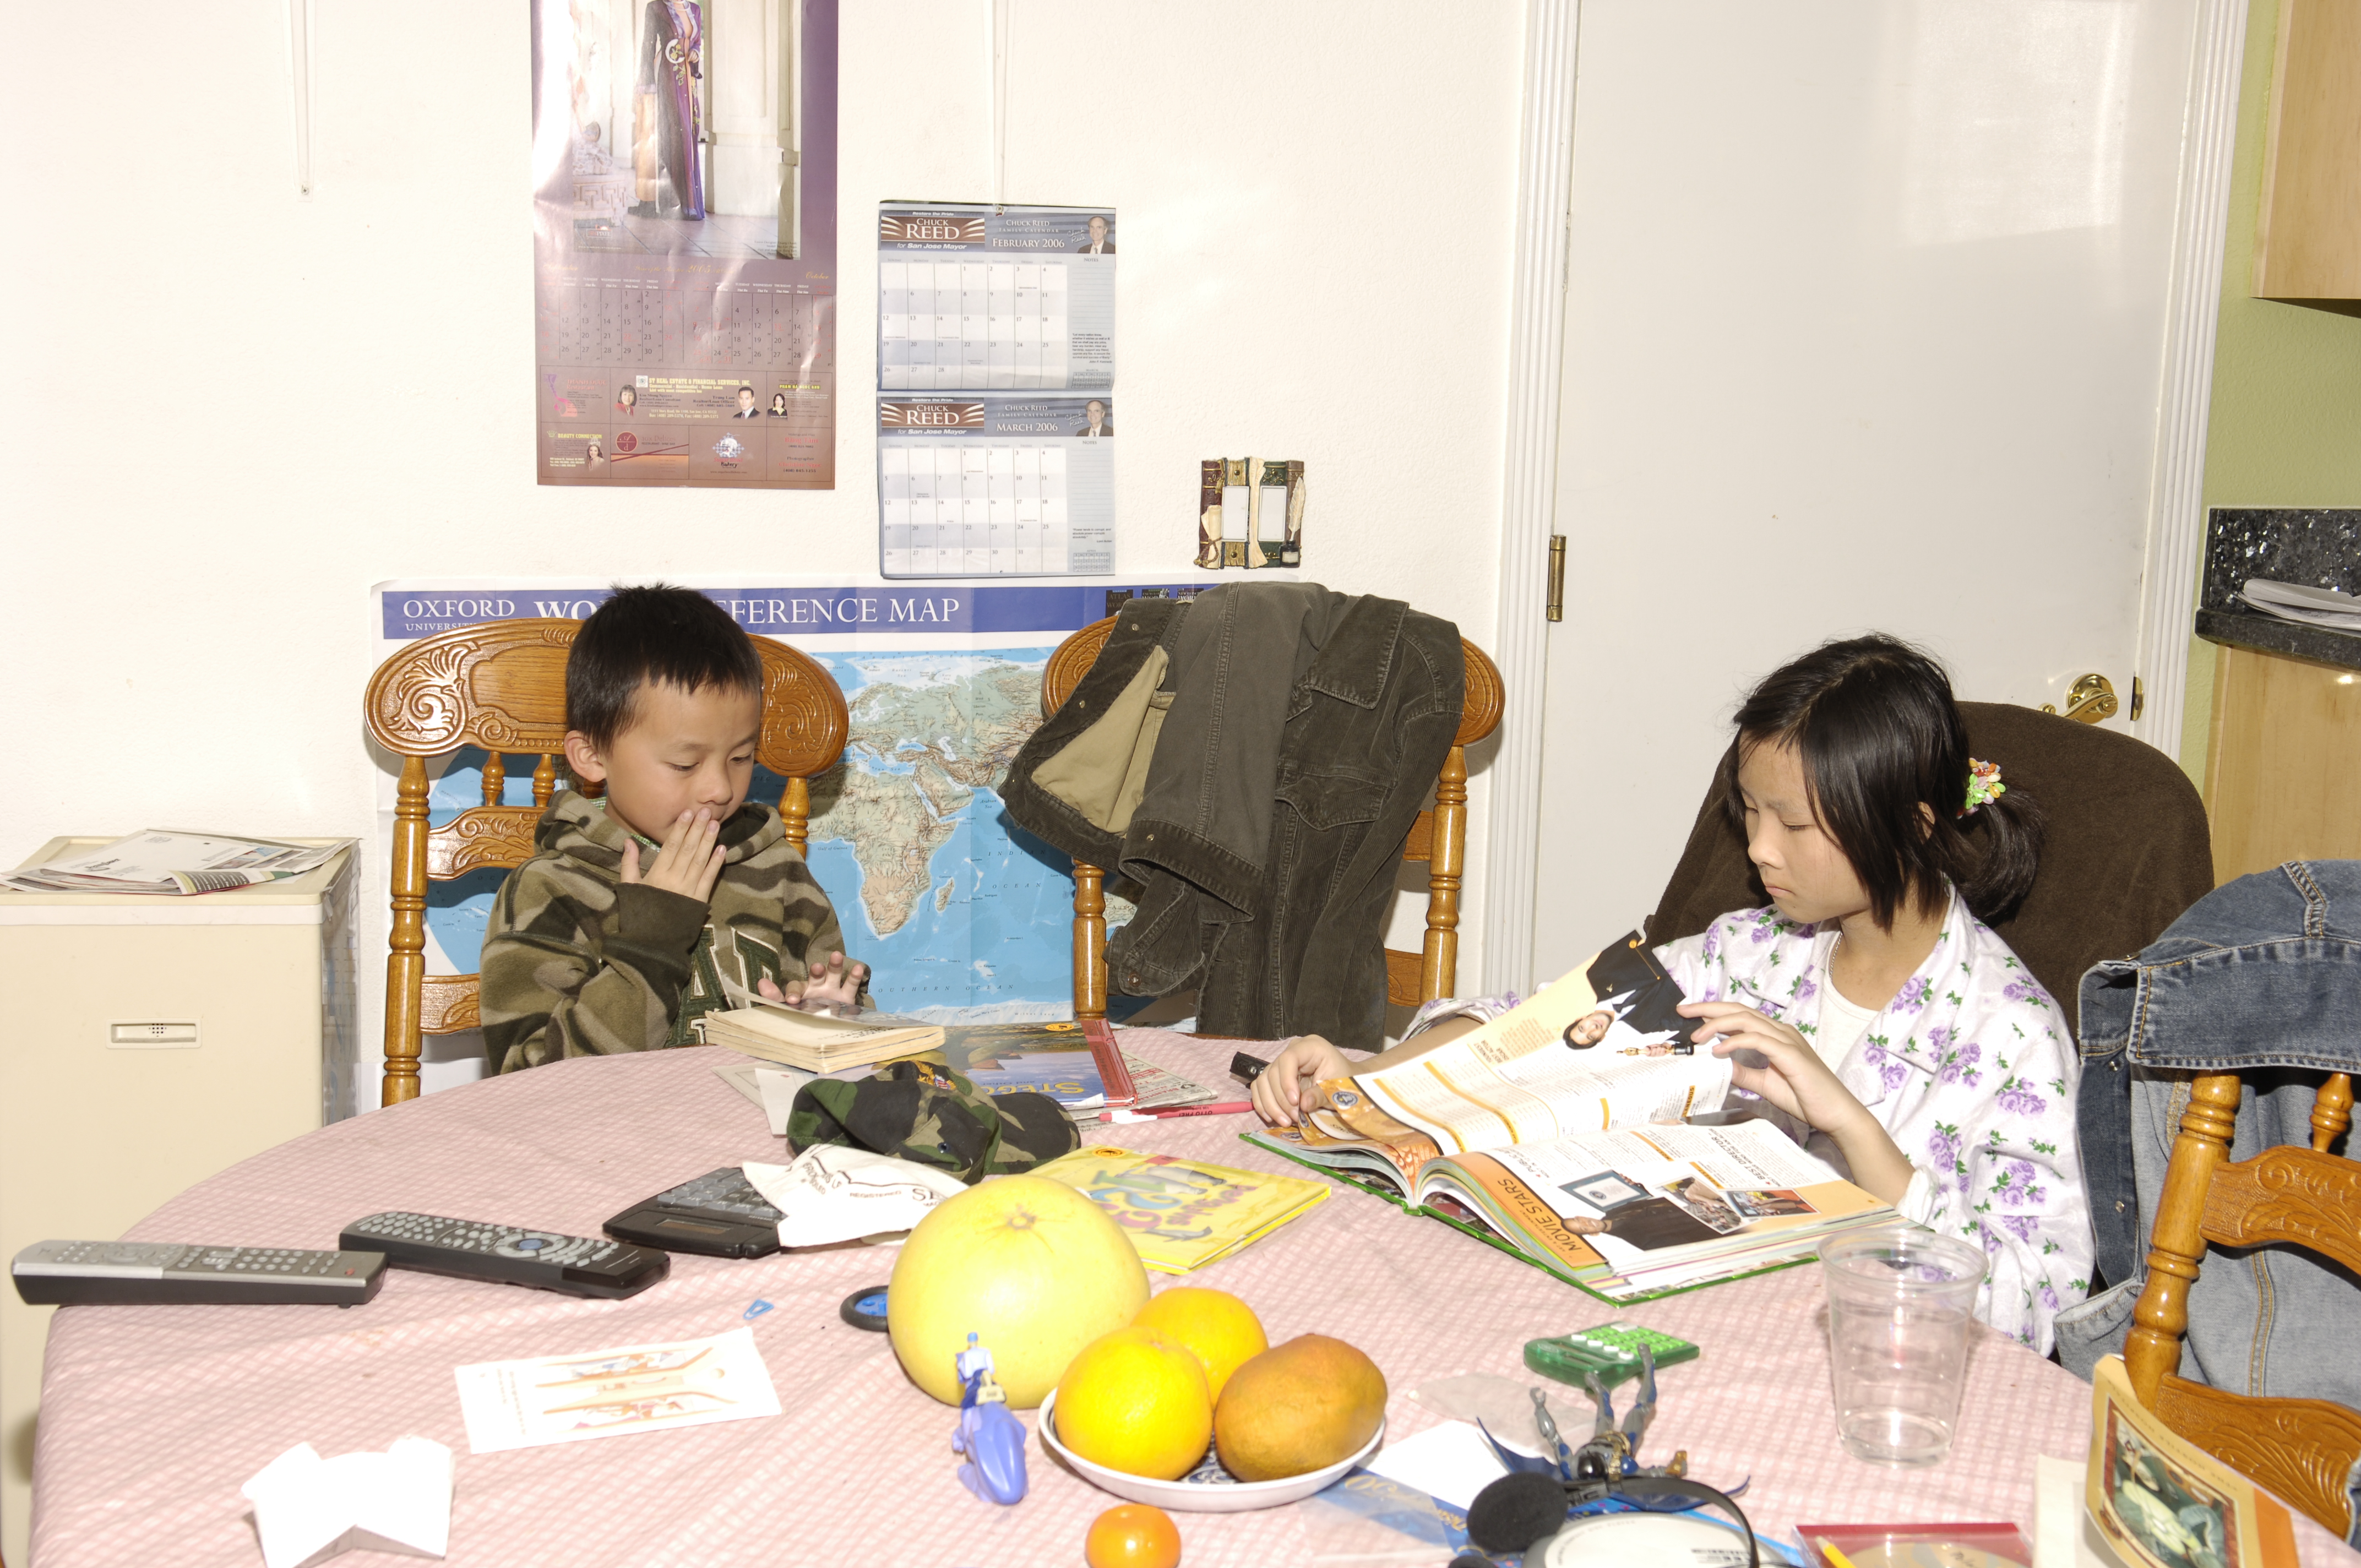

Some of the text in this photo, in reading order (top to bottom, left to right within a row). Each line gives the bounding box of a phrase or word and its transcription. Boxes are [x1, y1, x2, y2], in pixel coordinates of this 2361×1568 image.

[905, 223, 960, 239] REED
[993, 238, 1064, 248] FEBRUARY 2006
[905, 410, 959, 424] REED
[997, 423, 1058, 431] MARCH 2006
[403, 600, 515, 618] OXFORD
[716, 598, 878, 623] FERENCE
[888, 598, 960, 623] MAP
[1497, 1177, 1582, 1250] MOVIE STARS
